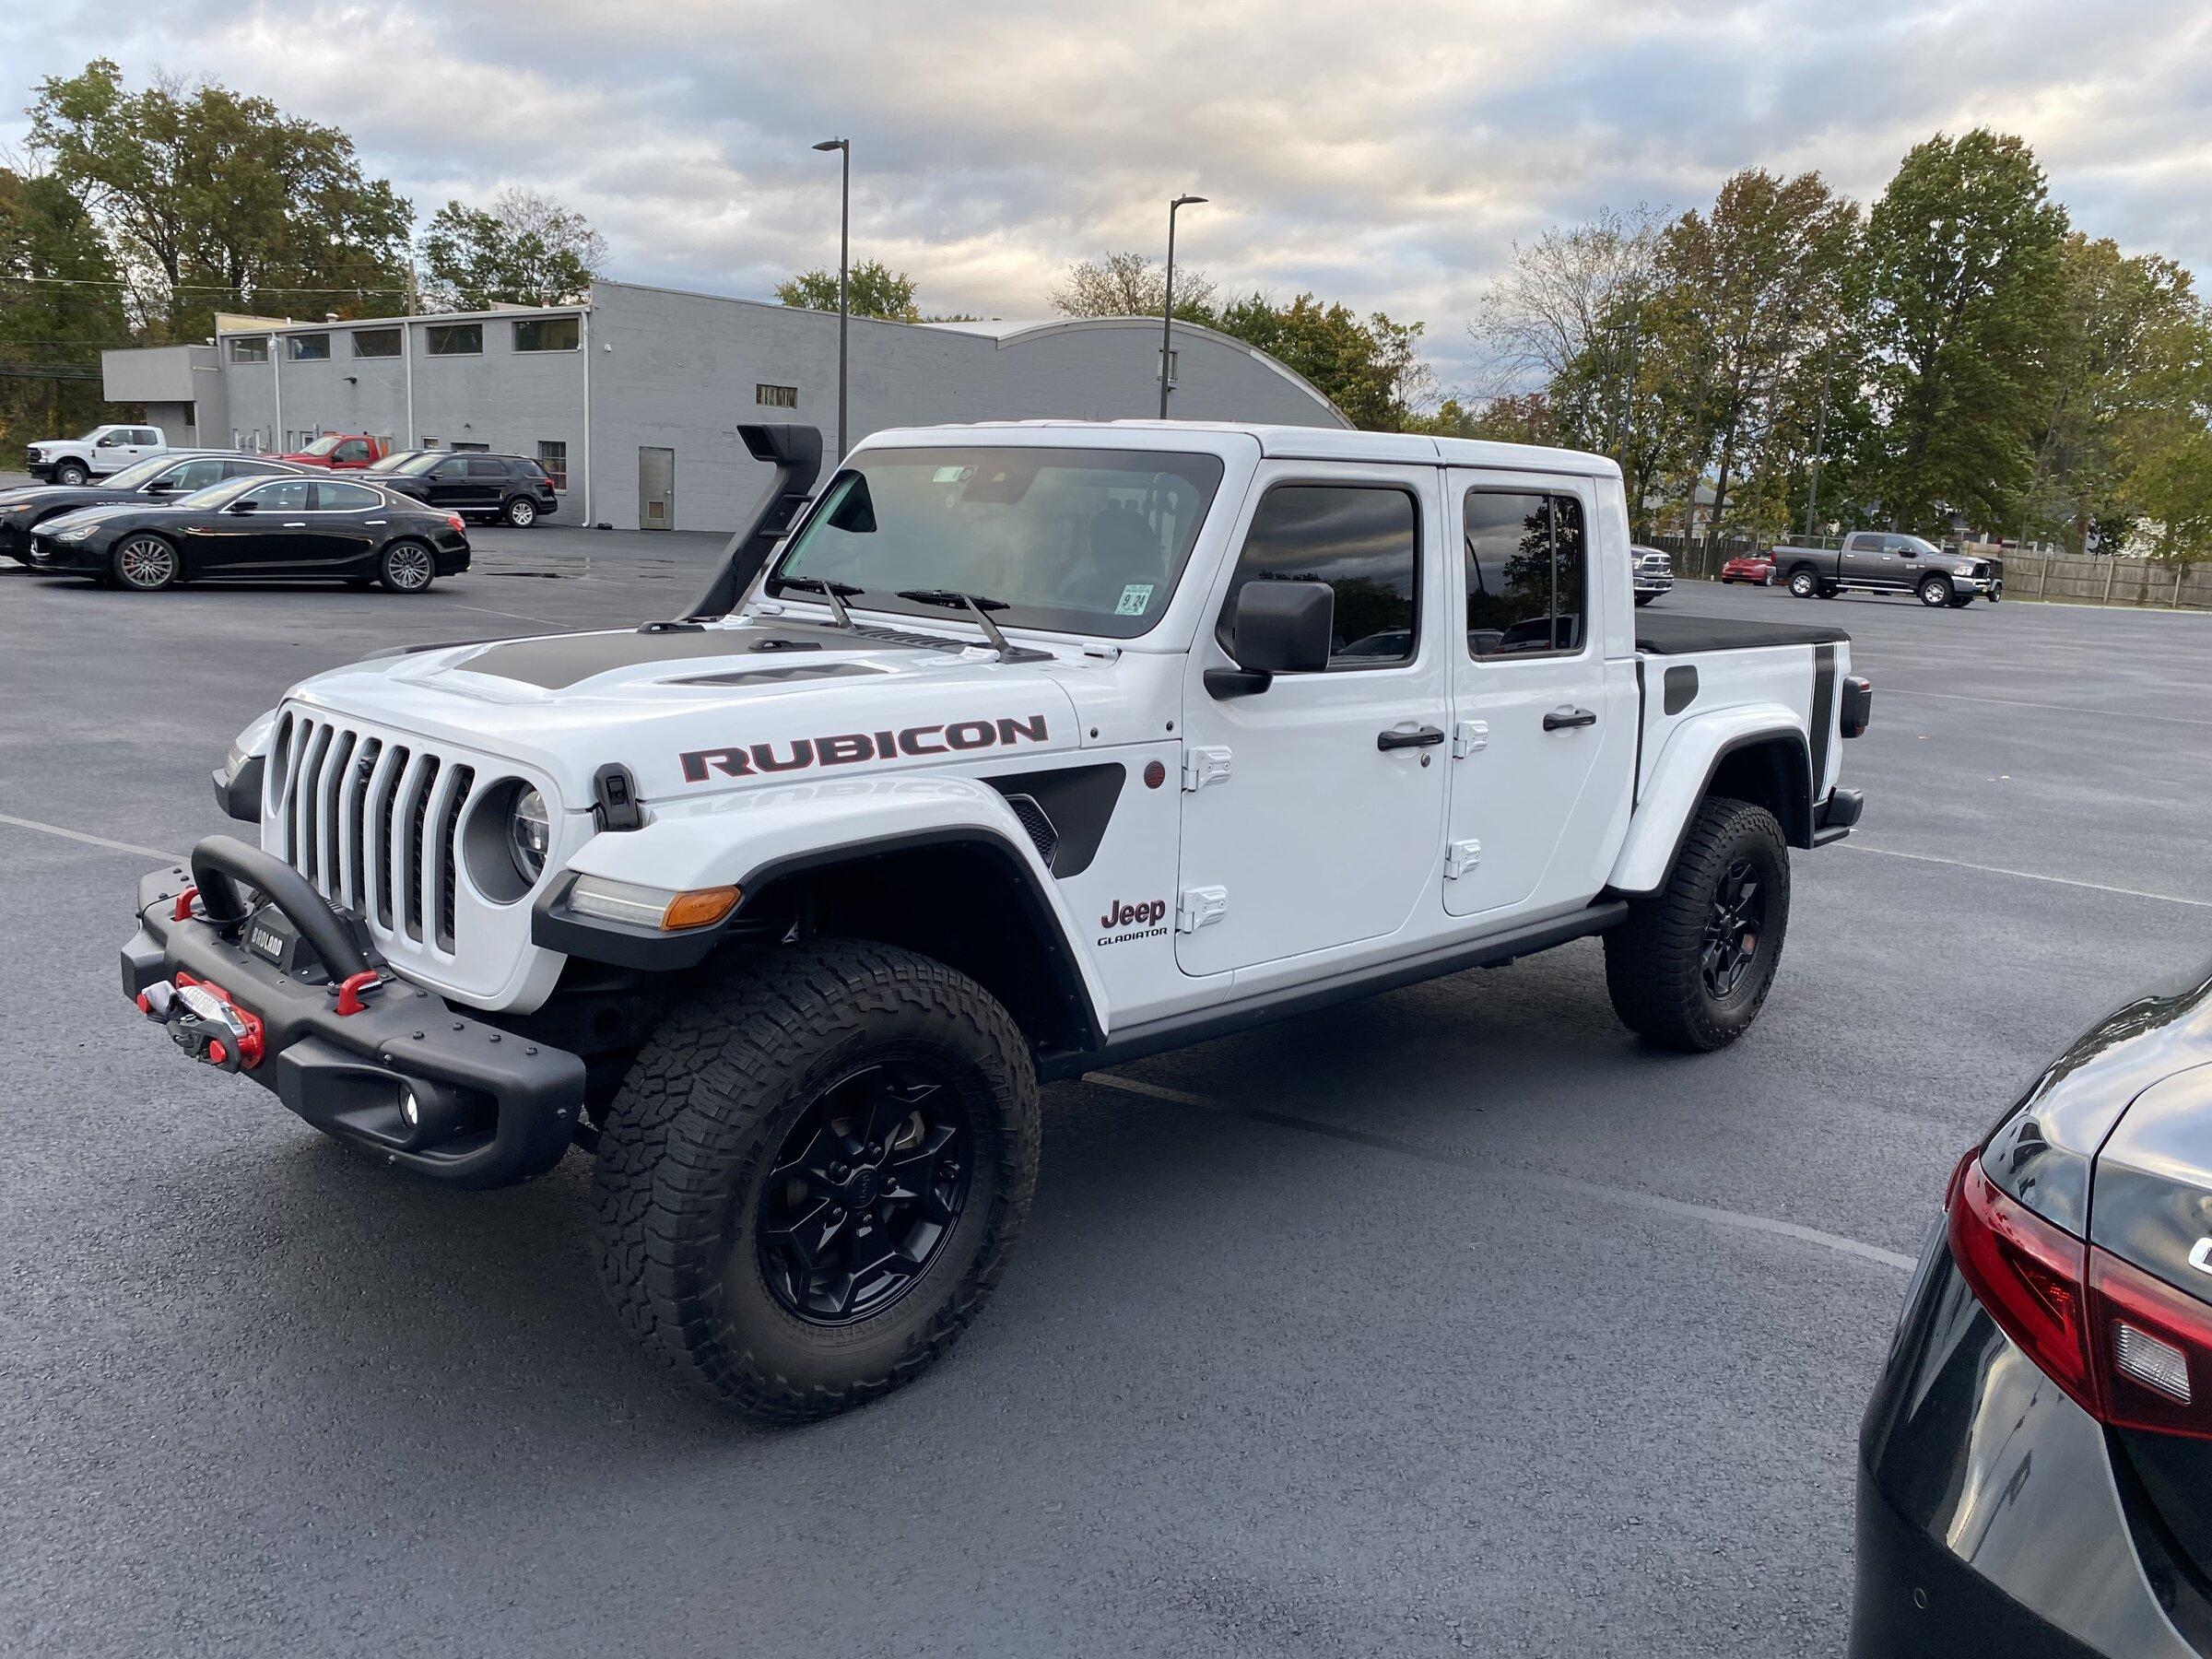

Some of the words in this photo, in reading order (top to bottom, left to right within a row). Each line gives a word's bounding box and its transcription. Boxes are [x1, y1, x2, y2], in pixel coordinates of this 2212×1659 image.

[1134, 594, 1146, 607] 24
[678, 714, 1049, 782] RUBICON
[1100, 899, 1166, 928] Jeep
[251, 927, 283, 957] BADLAND
[1097, 927, 1168, 947] GLADIATOR
